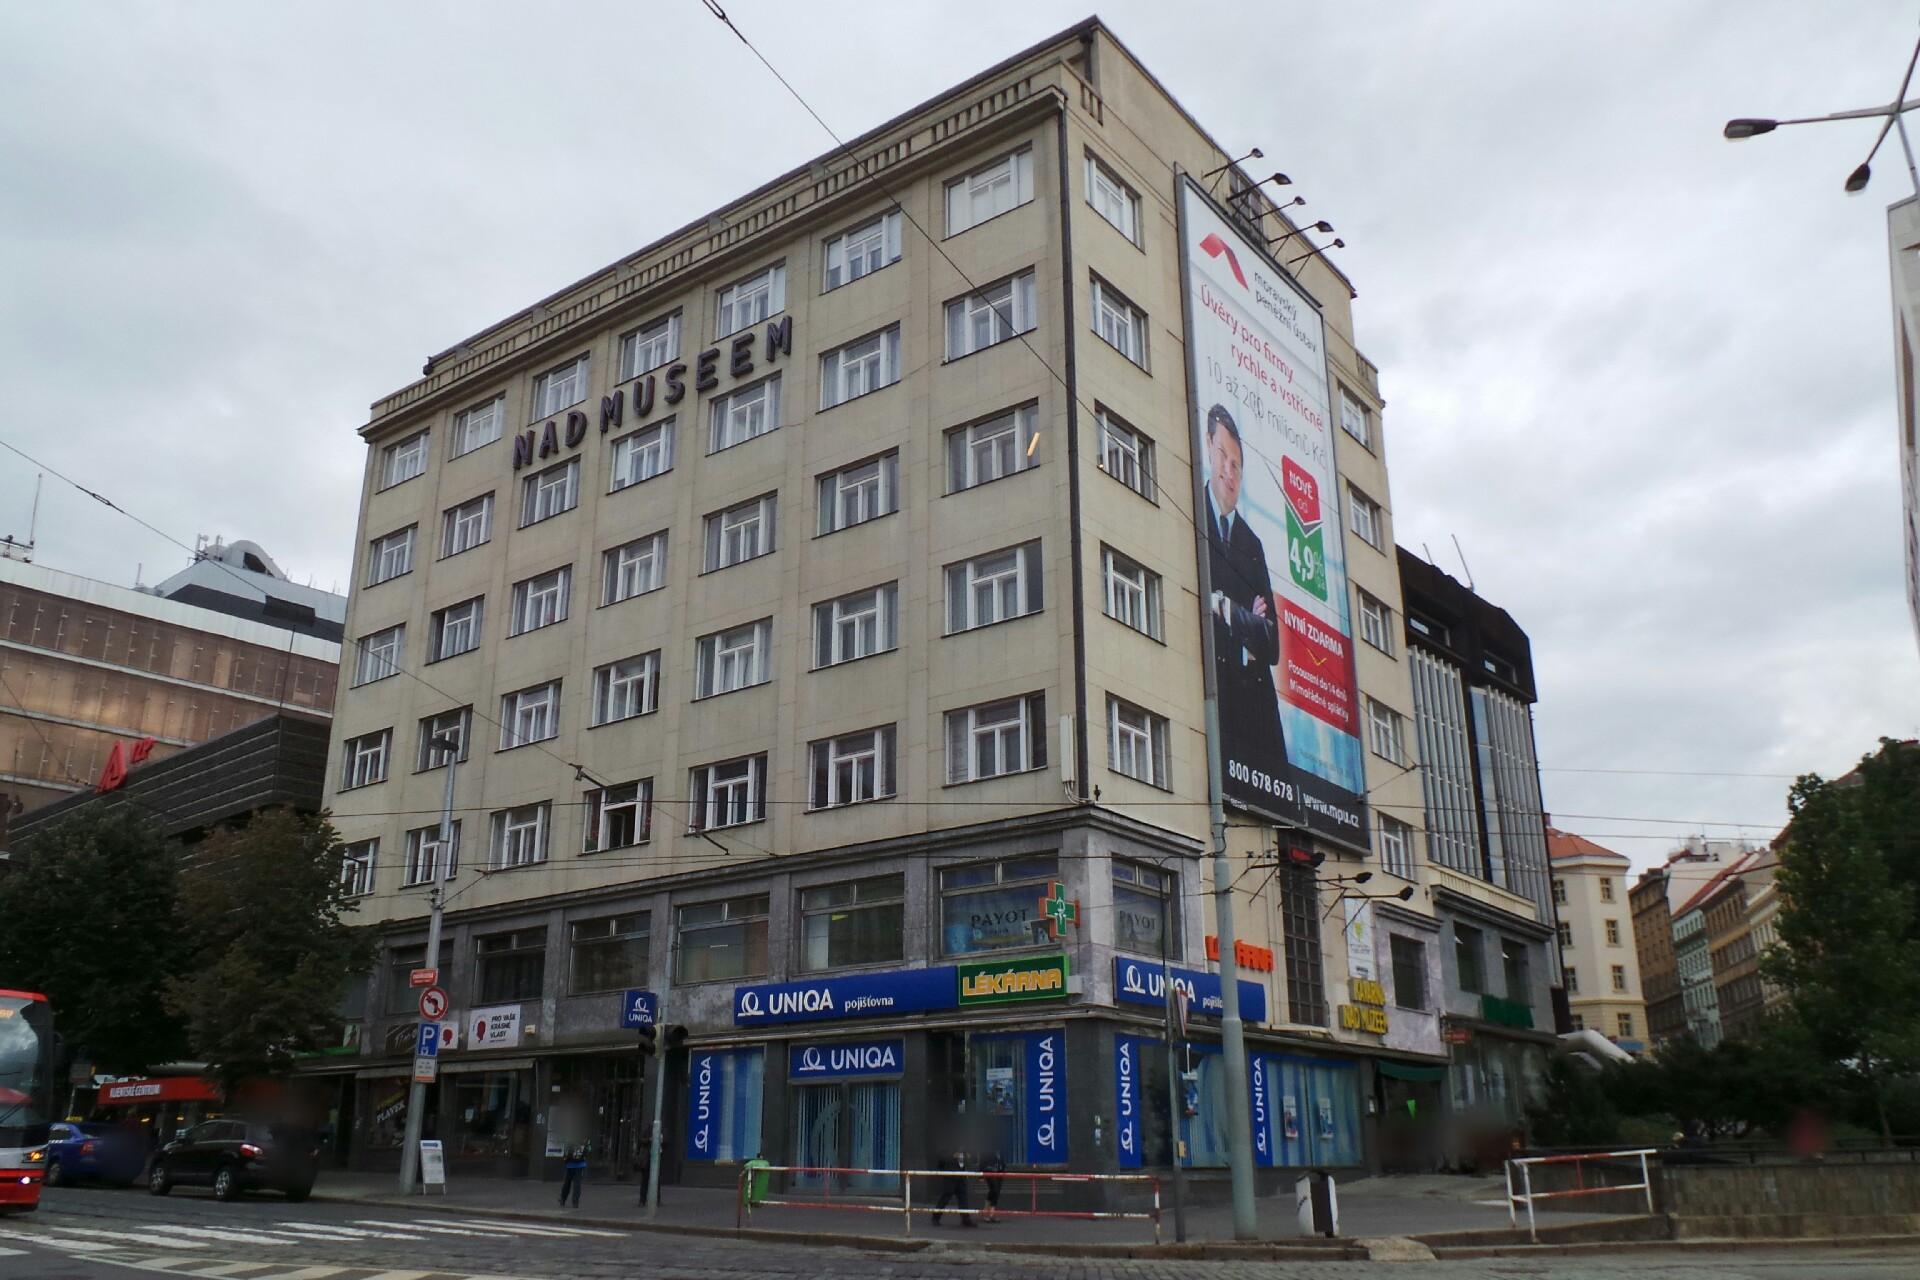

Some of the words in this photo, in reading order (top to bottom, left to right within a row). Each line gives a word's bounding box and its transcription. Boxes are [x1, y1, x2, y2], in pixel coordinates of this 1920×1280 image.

[1201, 284, 1237, 335] Úvěry
[1241, 325, 1261, 352] pro
[1263, 341, 1294, 384] firmy
[513, 409, 587, 470] NAD
[600, 315, 793, 433] MUSEEM
[1207, 356, 1222, 384] 10
[1225, 375, 1240, 400] až
[1243, 384, 1264, 419] 200
[1231, 344, 1268, 386] rychle
[1270, 377, 1277, 394] a
[1284, 609, 1306, 635] NYNÍ
[1307, 623, 1344, 659] ZDARMA
[1229, 760, 1250, 784] 800
[1251, 770, 1272, 793] 678
[1273, 780, 1293, 802] 678
[1303, 793, 1360, 828] www.mpu.cz
[971, 908, 1029, 928] PAYOT
[1119, 910, 1157, 930] PAYOT
[769, 988, 834, 1015] UNIQA
[844, 994, 894, 1012] pojišťovna
[962, 968, 1062, 997] LÉKÁRNA
[422, 1026, 435, 1045] P
[489, 1030, 507, 1039] VLASY
[628, 1013, 653, 1023] UNIQA
[830, 1046, 896, 1071] UNIQA
[1039, 1036, 1054, 1112] UNIQA
[1119, 1042, 1132, 1116] UNIQA
[698, 1056, 712, 1120] UNIQA
[1253, 1057, 1265, 1122] UNIQA
